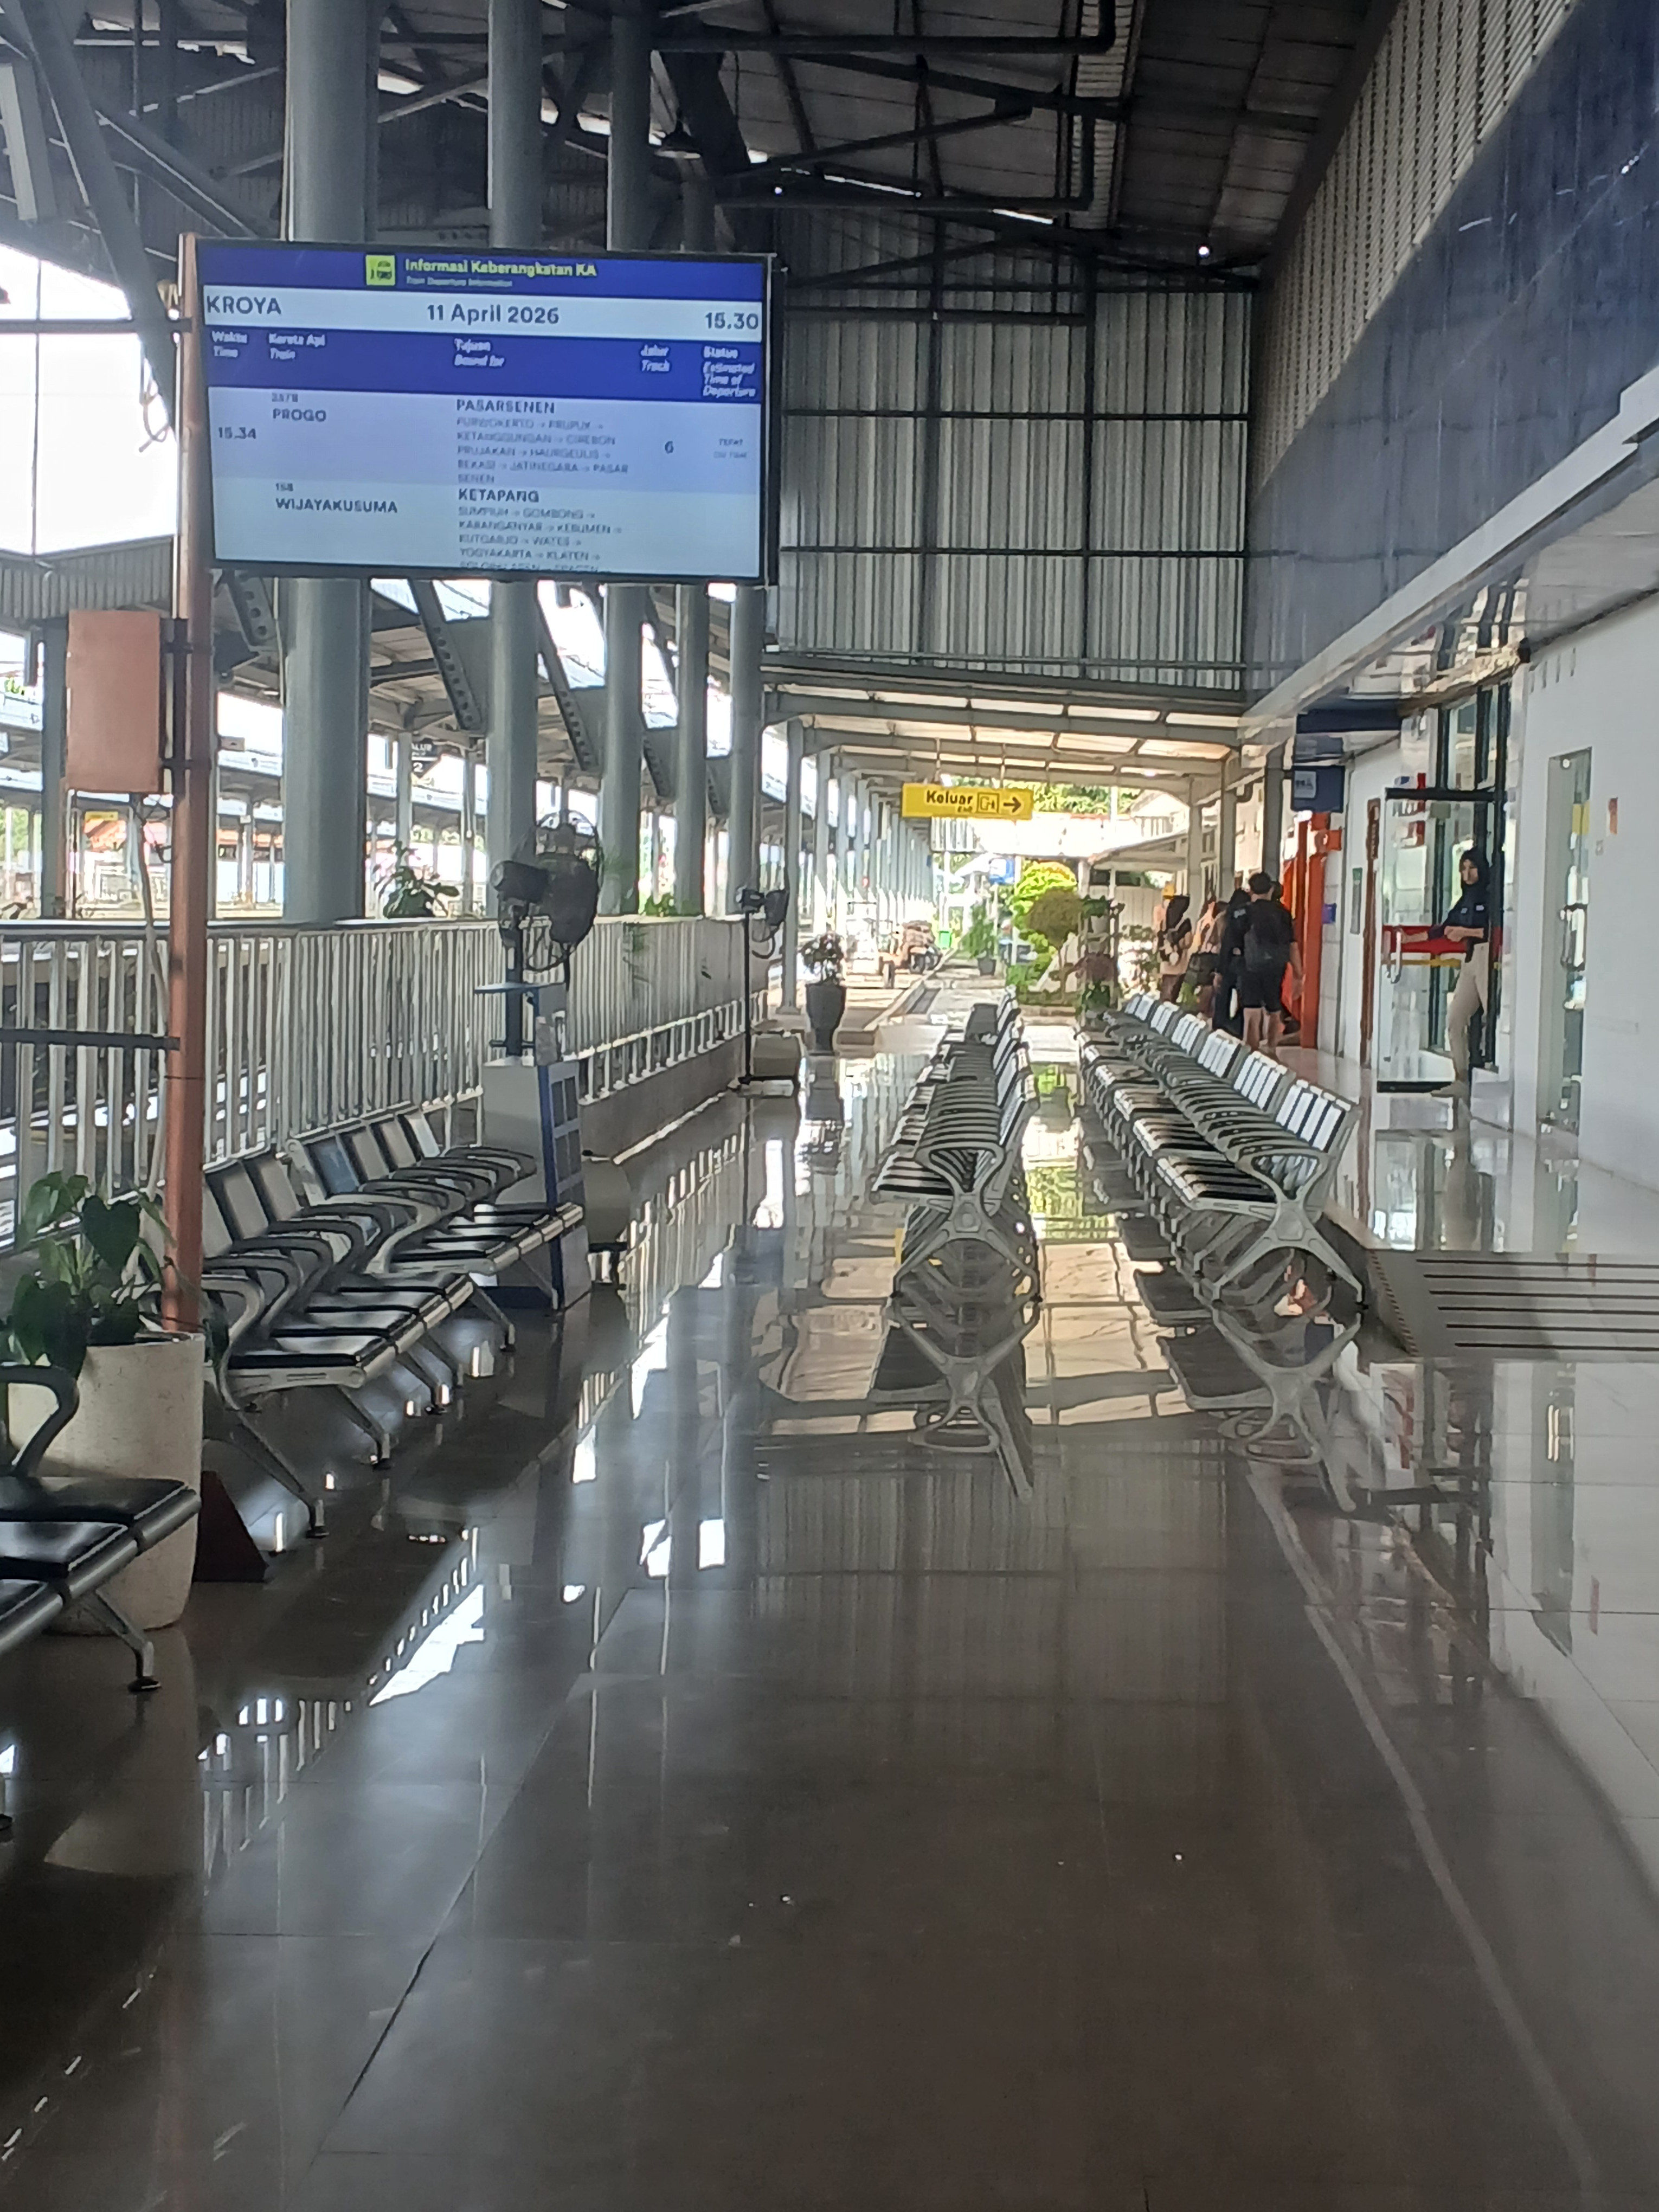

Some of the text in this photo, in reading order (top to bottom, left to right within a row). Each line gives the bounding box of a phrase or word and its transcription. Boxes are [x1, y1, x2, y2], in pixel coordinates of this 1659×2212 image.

[406, 259, 597, 277] Informasi Keberangkatan KA
[207, 295, 281, 314] KROYA
[428, 304, 558, 325] 11 April 2026
[705, 312, 758, 330] 15.30
[456, 399, 555, 413] PASARSENEN
[273, 408, 326, 422] PROGO
[459, 488, 539, 503] KETAPANG
[275, 498, 397, 513] WIJAYAKUSUMA
[927, 790, 973, 805] Keluar
